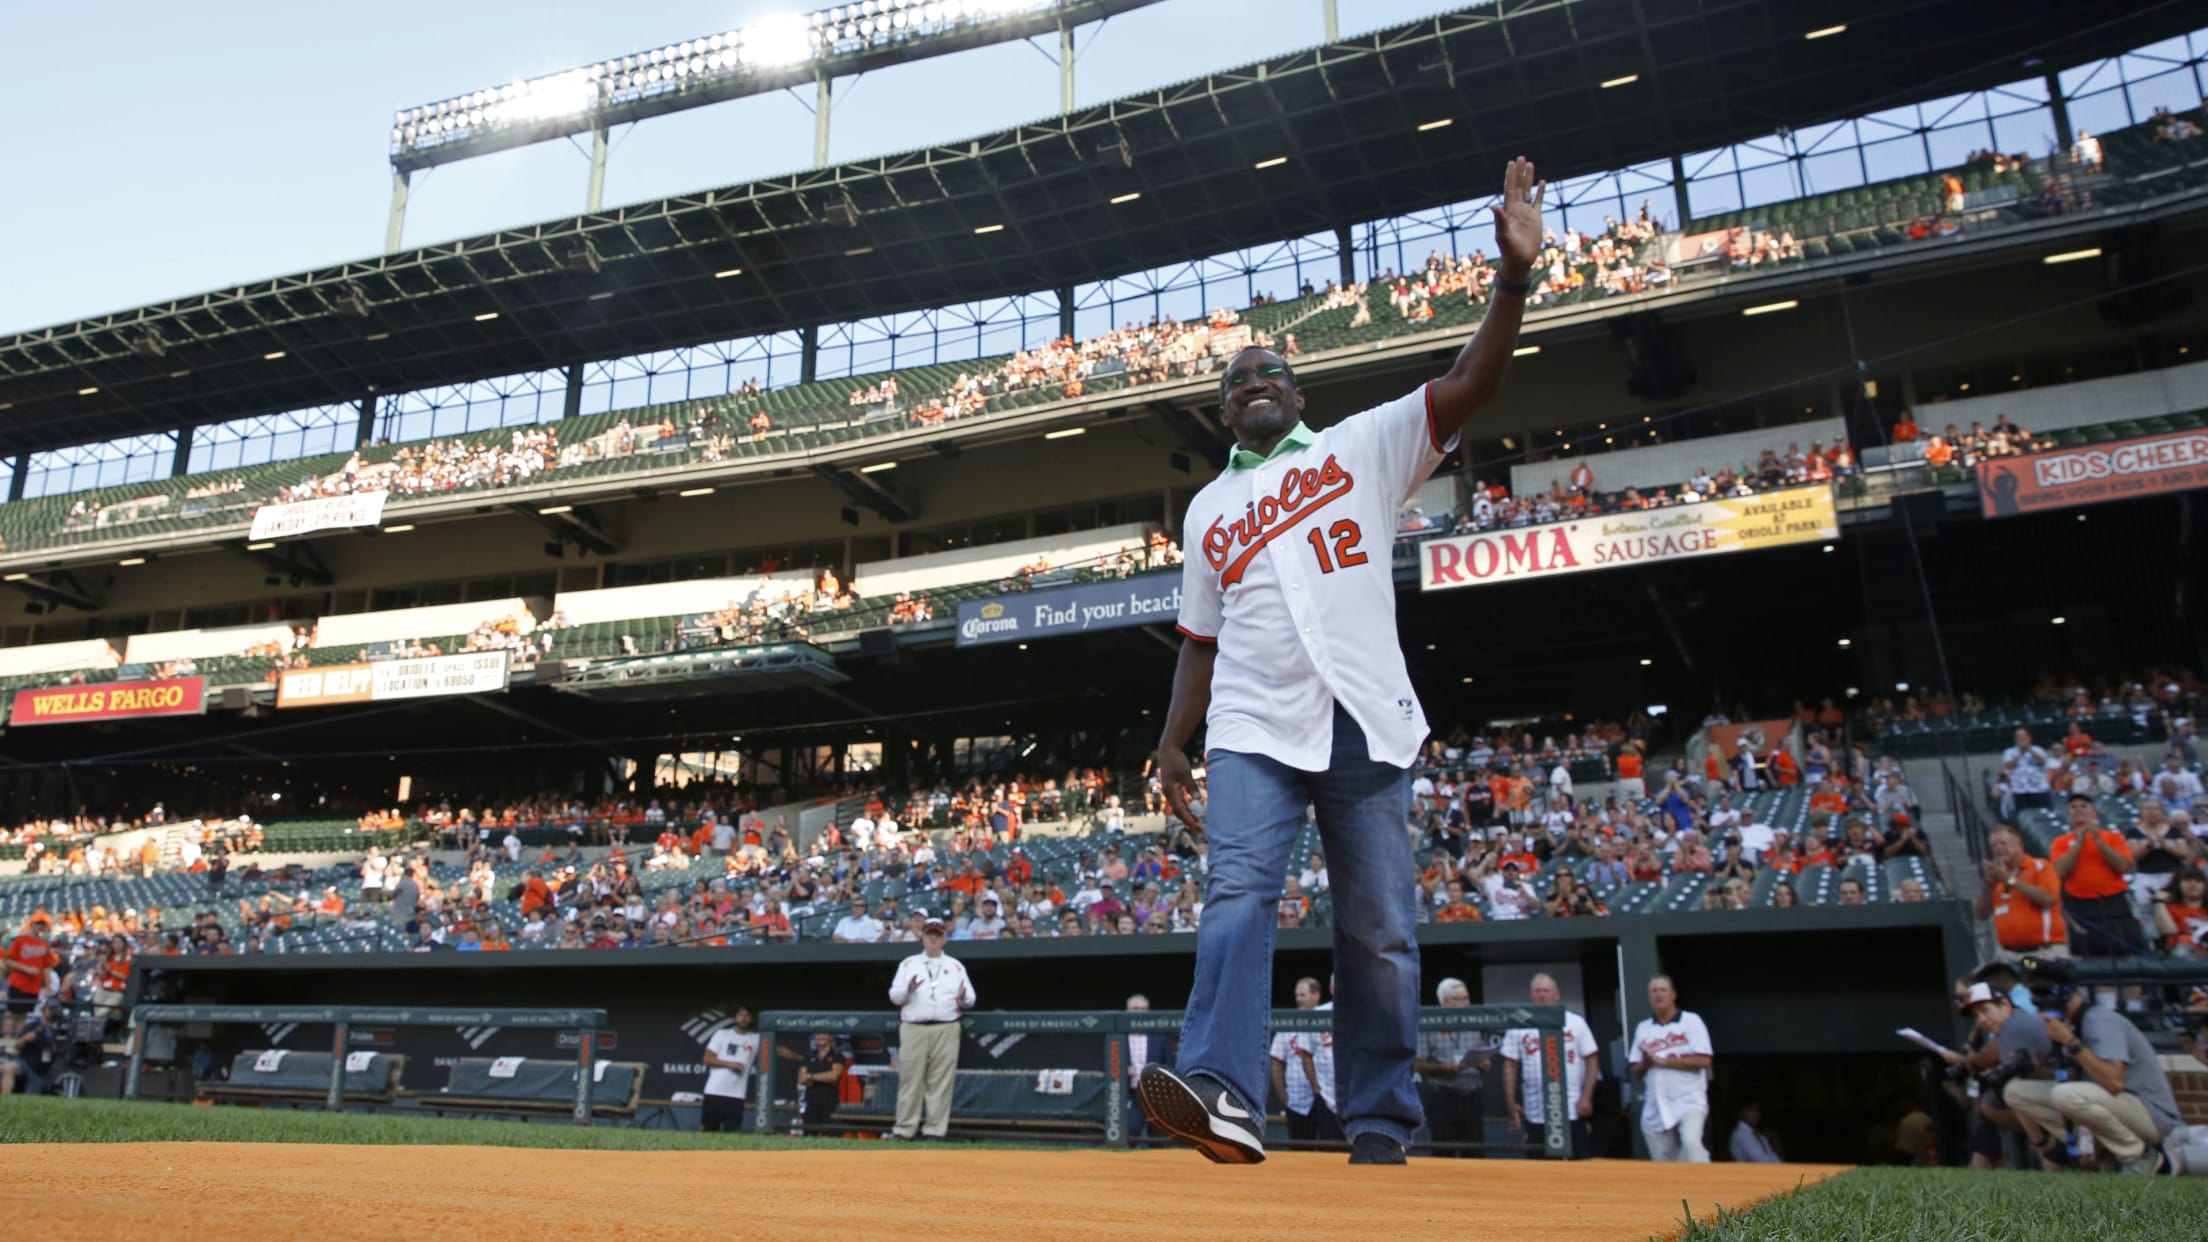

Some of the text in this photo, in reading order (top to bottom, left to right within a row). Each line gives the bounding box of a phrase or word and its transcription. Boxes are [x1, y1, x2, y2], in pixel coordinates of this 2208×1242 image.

[2037, 438, 2208, 484] KIDS CHEER
[1202, 453, 1354, 573] Orioles
[1743, 497, 1812, 516] AVAILABLE
[1307, 518, 1368, 575] 12
[1428, 526, 1580, 585] ROMA
[1594, 528, 1718, 564] SAUSAGE
[1034, 585, 1184, 630] Find your beach
[961, 616, 1018, 640] Corona
[33, 685, 184, 716] WELLS FARGO
[1003, 1019, 1027, 1029] BANK
[1041, 1019, 1080, 1029] AMERICA
[1130, 1019, 1153, 1029] BANK
[1155, 1019, 1169, 1029] OF
[1272, 1018, 1295, 1028] ANK
[1296, 1018, 1310, 1028] OF
[1420, 1014, 1443, 1025] ANK
[1460, 1014, 1509, 1025] AMERICA
[663, 1063, 707, 1075] BANK OF
[1105, 1040, 1120, 1142] Orioles.com
[1542, 1035, 1562, 1149] Orioles.com
